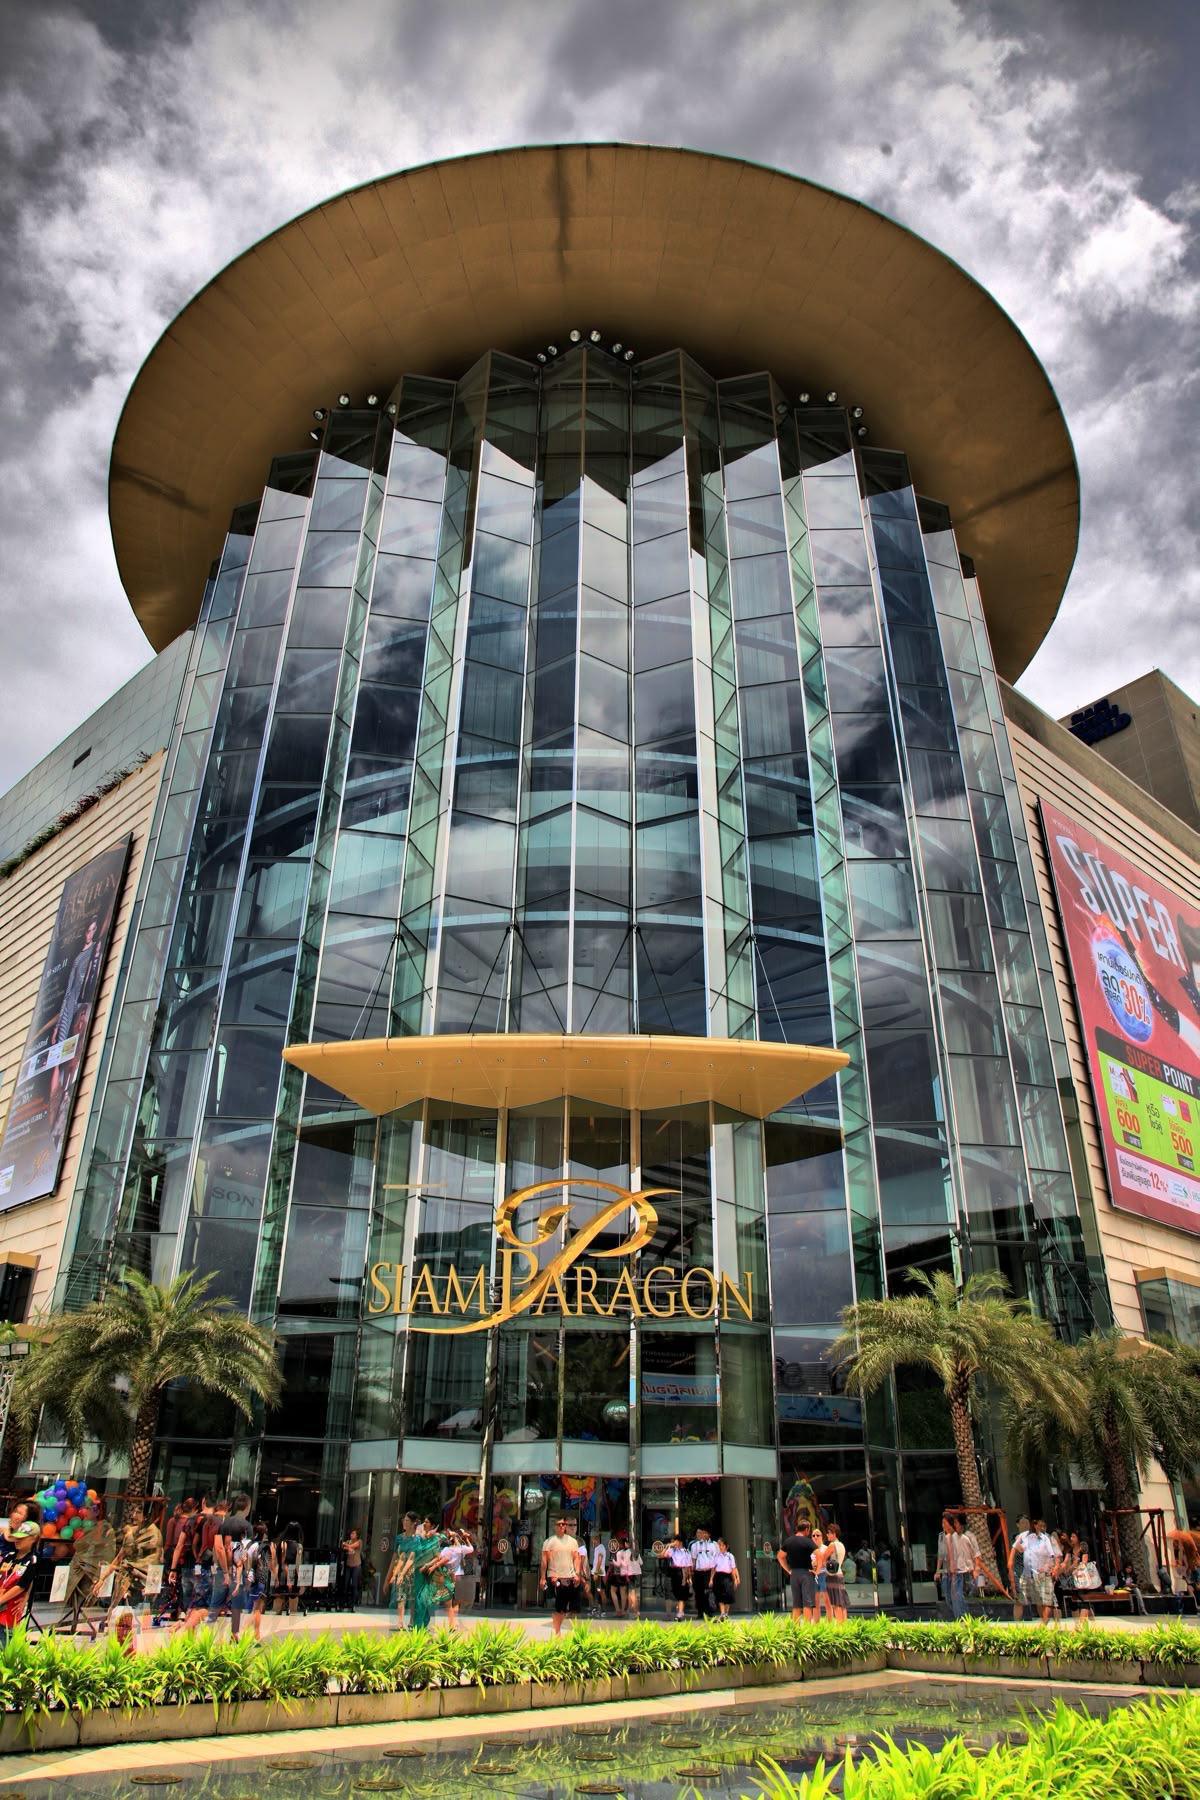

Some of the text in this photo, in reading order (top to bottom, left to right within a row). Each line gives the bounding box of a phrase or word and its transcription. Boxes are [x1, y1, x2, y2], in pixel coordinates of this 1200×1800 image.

[1055, 835, 1187, 973] SUPER
[1102, 970, 1120, 994] ลด
[1125, 1044, 1163, 1080] SUPER
[1162, 1063, 1194, 1095] POINT
[1116, 1107, 1141, 1134] 600
[1170, 1131, 1194, 1157] 500
[367, 1248, 754, 1321] SIAM PARAGON
